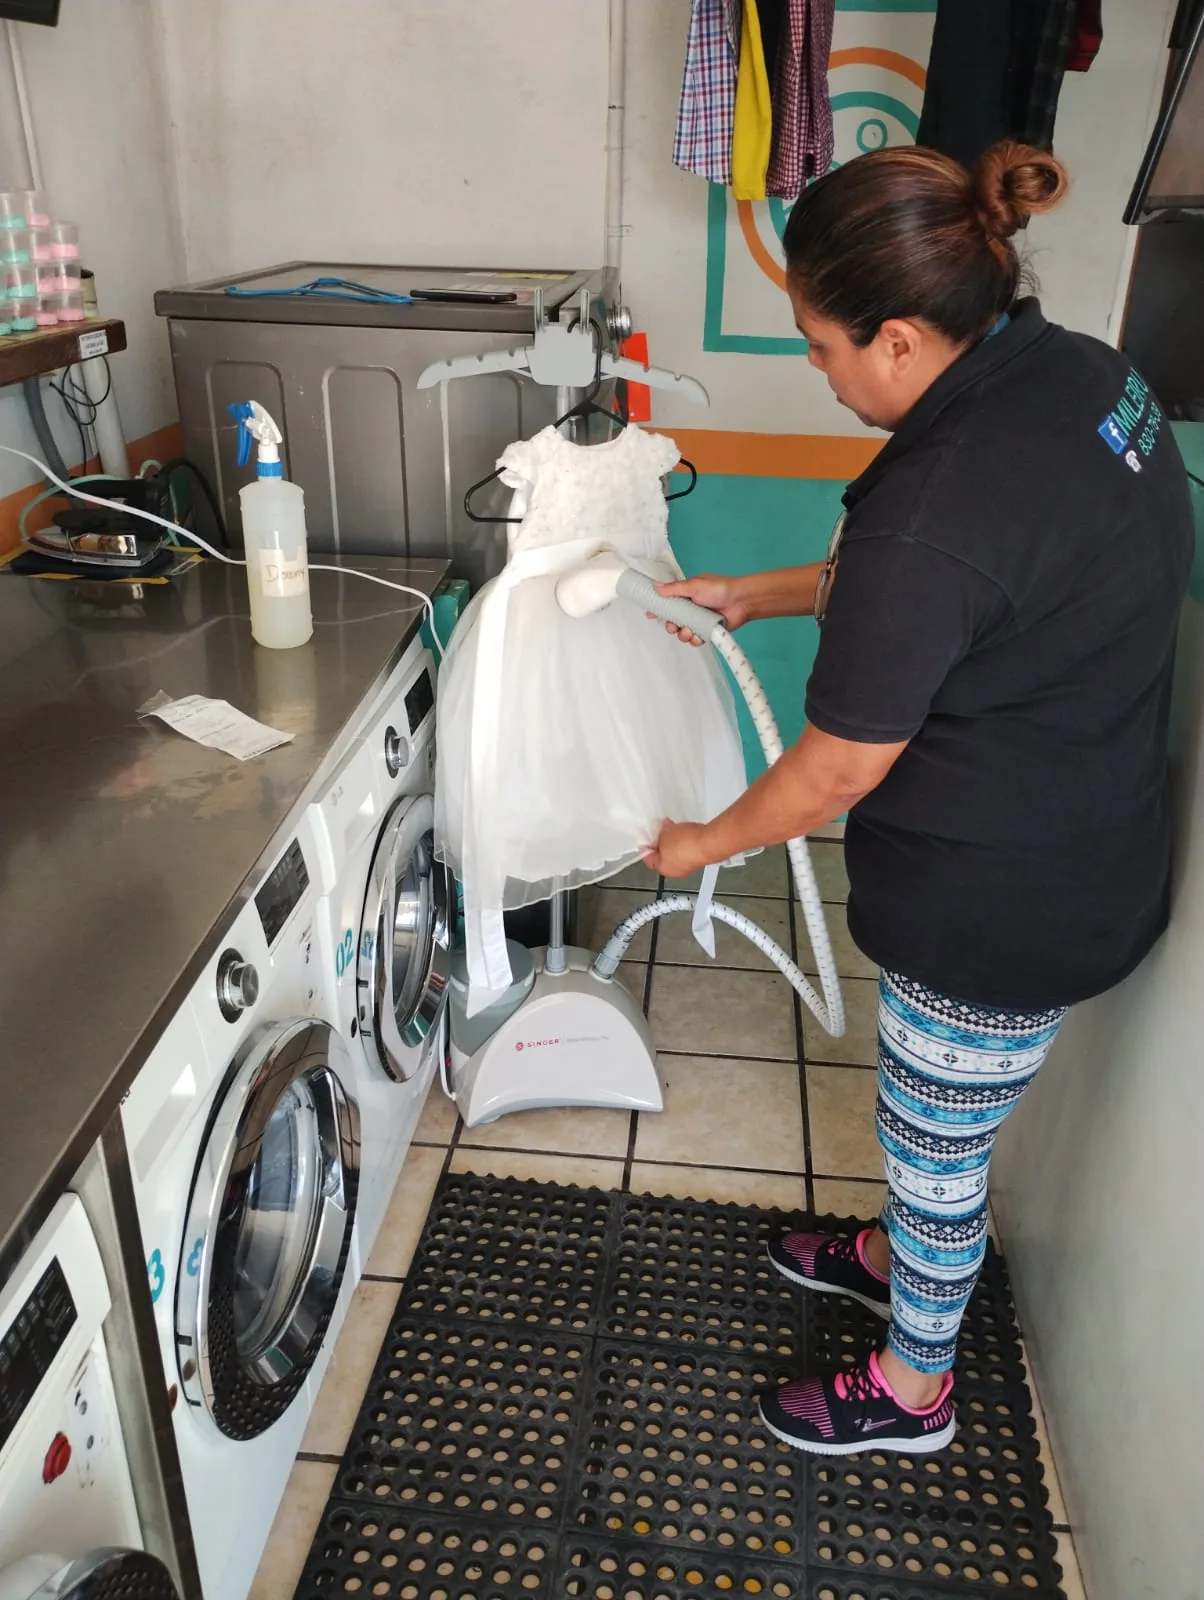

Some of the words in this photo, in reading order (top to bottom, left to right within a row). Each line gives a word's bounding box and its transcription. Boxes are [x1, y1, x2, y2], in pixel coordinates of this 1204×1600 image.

[335, 927, 354, 977] 02
[527, 1037, 560, 1048] SINGER
[147, 1247, 166, 1304] 3
